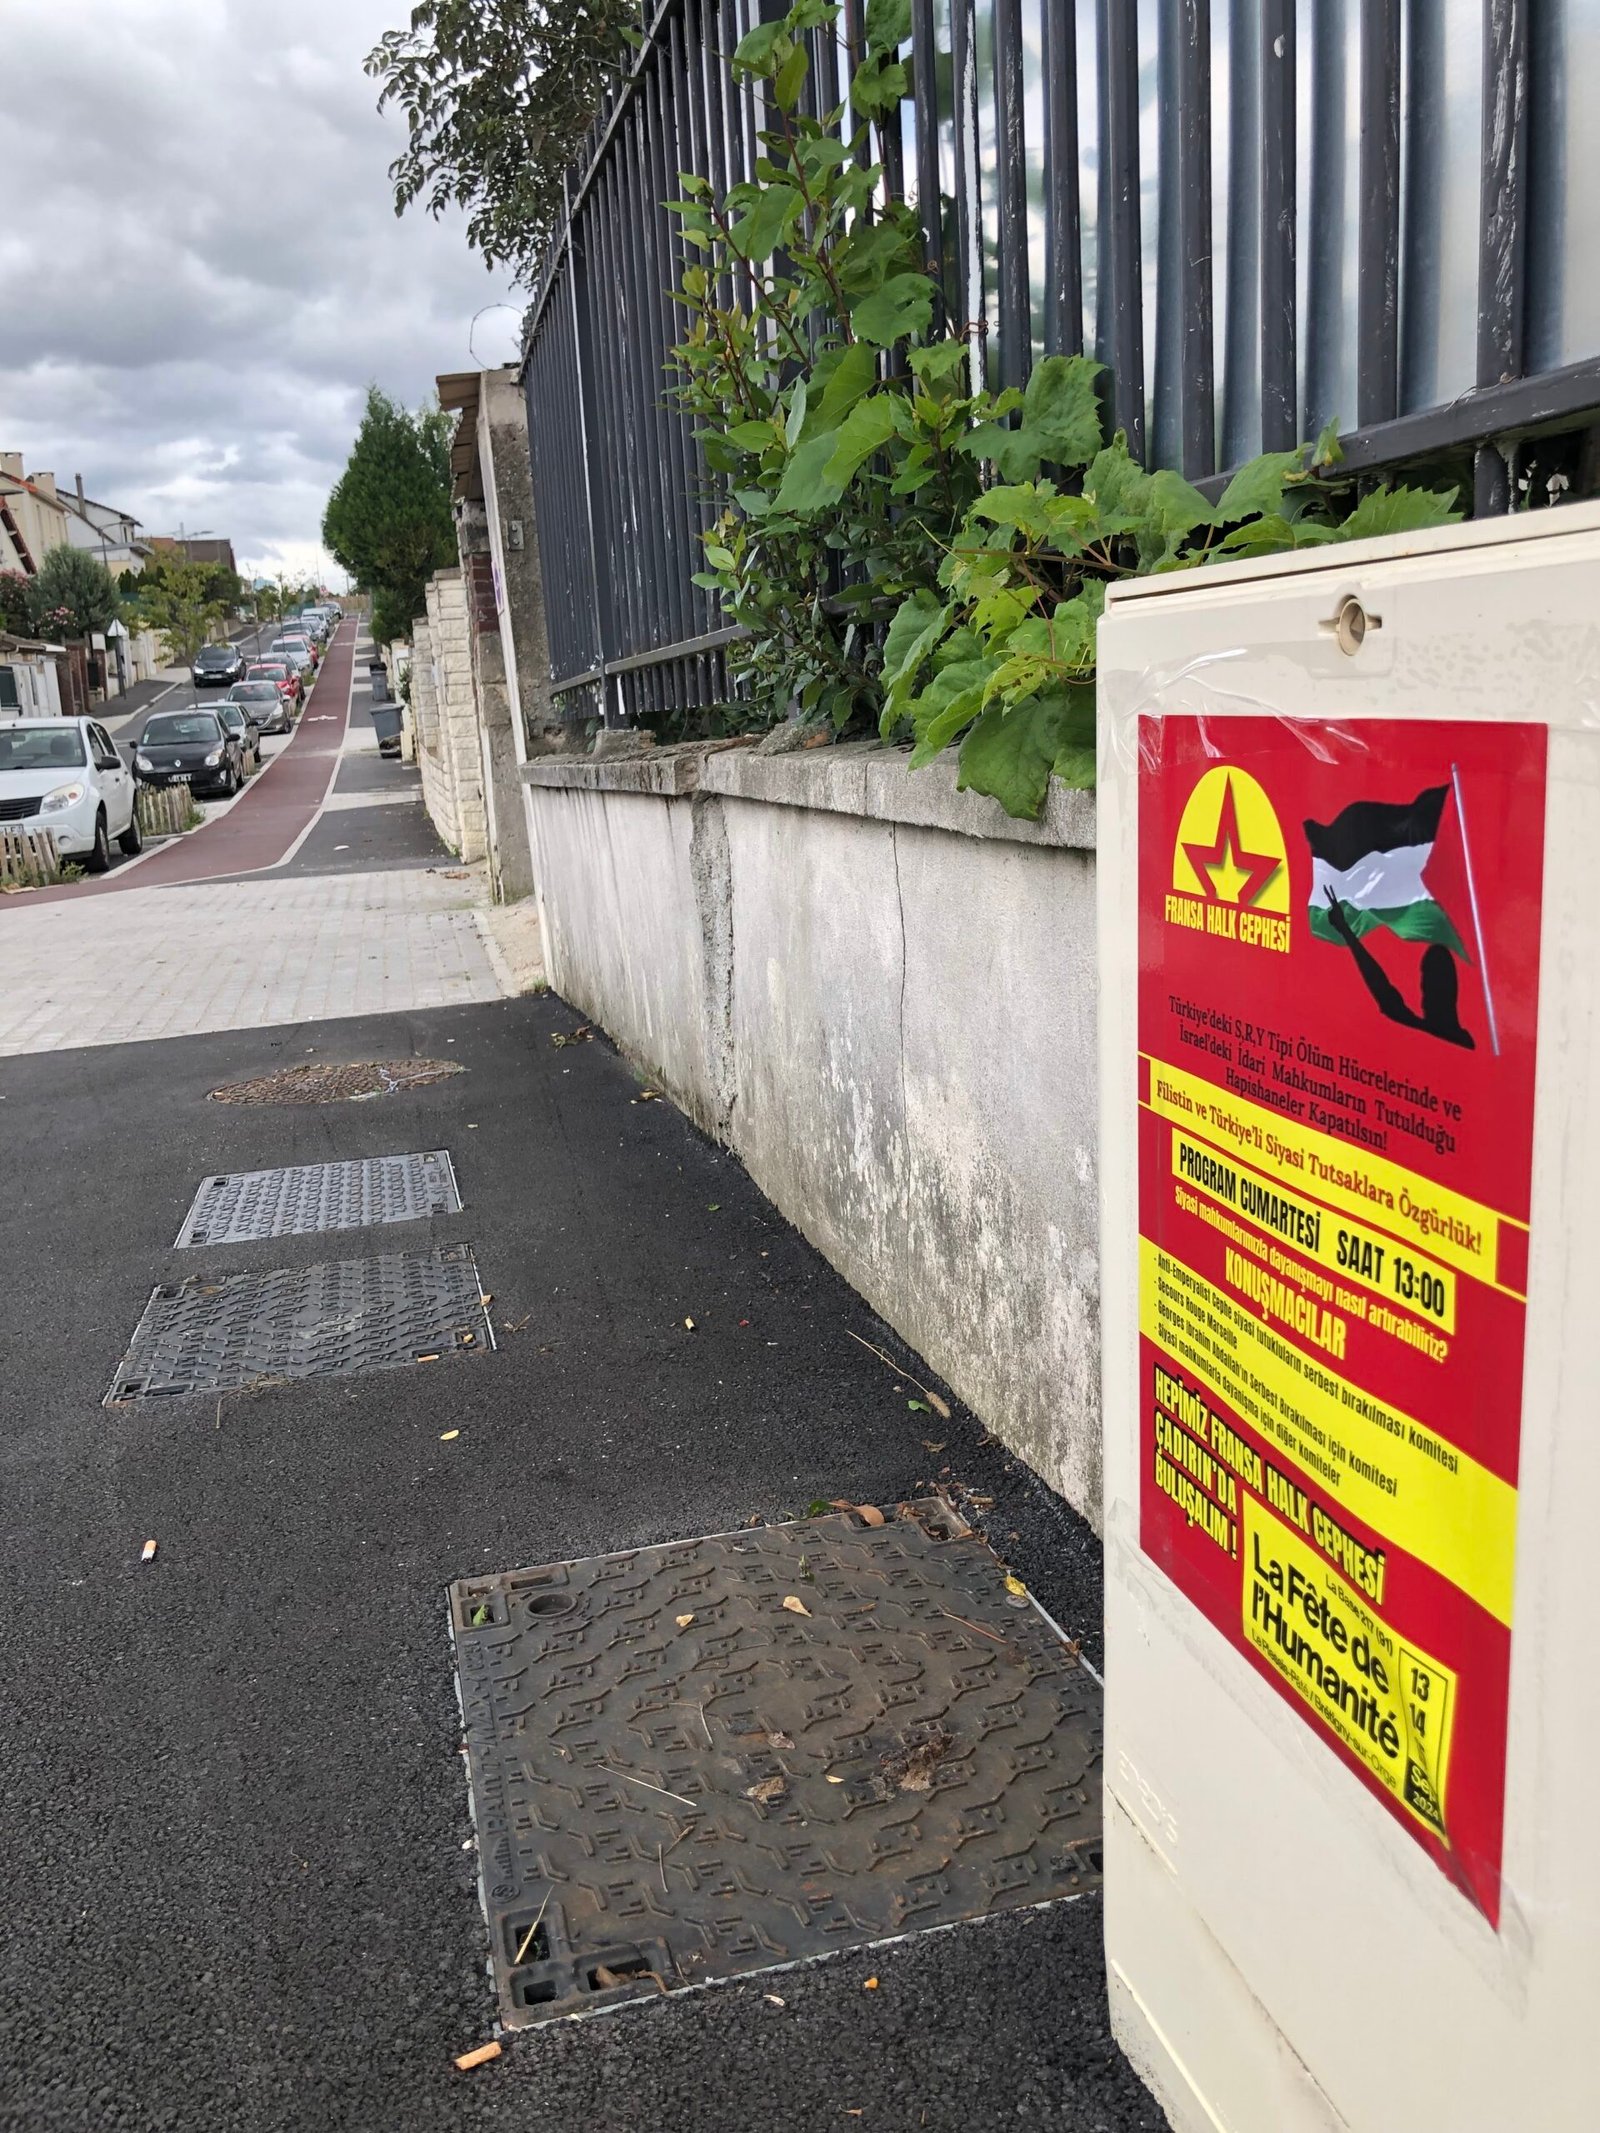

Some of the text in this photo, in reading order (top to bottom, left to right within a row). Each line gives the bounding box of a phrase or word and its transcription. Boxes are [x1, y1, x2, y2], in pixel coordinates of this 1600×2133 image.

[1166, 895, 1290, 953] FRANSA HALK CEPHESİ
[1169, 996, 1232, 1034] Türkiye'deki
[1267, 1031, 1292, 1061] Tipi
[1296, 1036, 1335, 1072] Ölüm
[1338, 1056, 1438, 1112] Hücrelerinde
[1443, 1100, 1462, 1121] ve
[1180, 1020, 1456, 1155] İsrael'deki İdari Mahkumların Tutulduğu
[1226, 1067, 1388, 1151] Hapishaneler Kapatılsın!
[1157, 1080, 1481, 1255] Filistin ve Türkiye'li Siyasi Tutsaklara Özgürlük!
[1180, 1143, 1444, 1317] PROGRAM CUMARTESİ SAAT 13:00
[1158, 1276, 1237, 1350] Secours Rouge Marseille
[1176, 1186, 1198, 1215] Siyasi
[1270, 1247, 1334, 1301] dayanışmayı
[1336, 1287, 1366, 1319] nasıl
[1368, 1304, 1448, 1363] artırabiliriz?
[1226, 1247, 1346, 1360] KONUŞMACILAR
[1158, 1253, 1458, 1474] Anti-Emperyalist Cephe siyasi tutukluların serbest bırakılması komitesi
[1158, 1300, 1184, 1330] Georges
[1250, 1373, 1278, 1409] Serbest
[1280, 1398, 1326, 1448] Bırakılması
[1328, 1435, 1346, 1463] için
[1349, 1450, 1397, 1497] komitesi
[1158, 1322, 1177, 1348] Siyasi
[1179, 1340, 1221, 1385] mahkumlarla
[1260, 1407, 1274, 1432] için
[1276, 1423, 1296, 1450] diğer
[1299, 1440, 1340, 1486] komiteler
[1156, 1412, 1236, 1515] ÇADIRIN'DA
[1156, 1368, 1385, 1605] HEPİMİZ FRANSA HALK CEPHESİ
[1156, 1452, 1228, 1551] BULUŞALIM
[1254, 1532, 1389, 1694] La Fête de
[1326, 1574, 1337, 1595] La
[1252, 1580, 1399, 1758] l'Humanité
[1410, 1703, 1426, 1738] 14
[1411, 1668, 1430, 1702] 13
[1412, 1790, 1440, 1823] 2024
